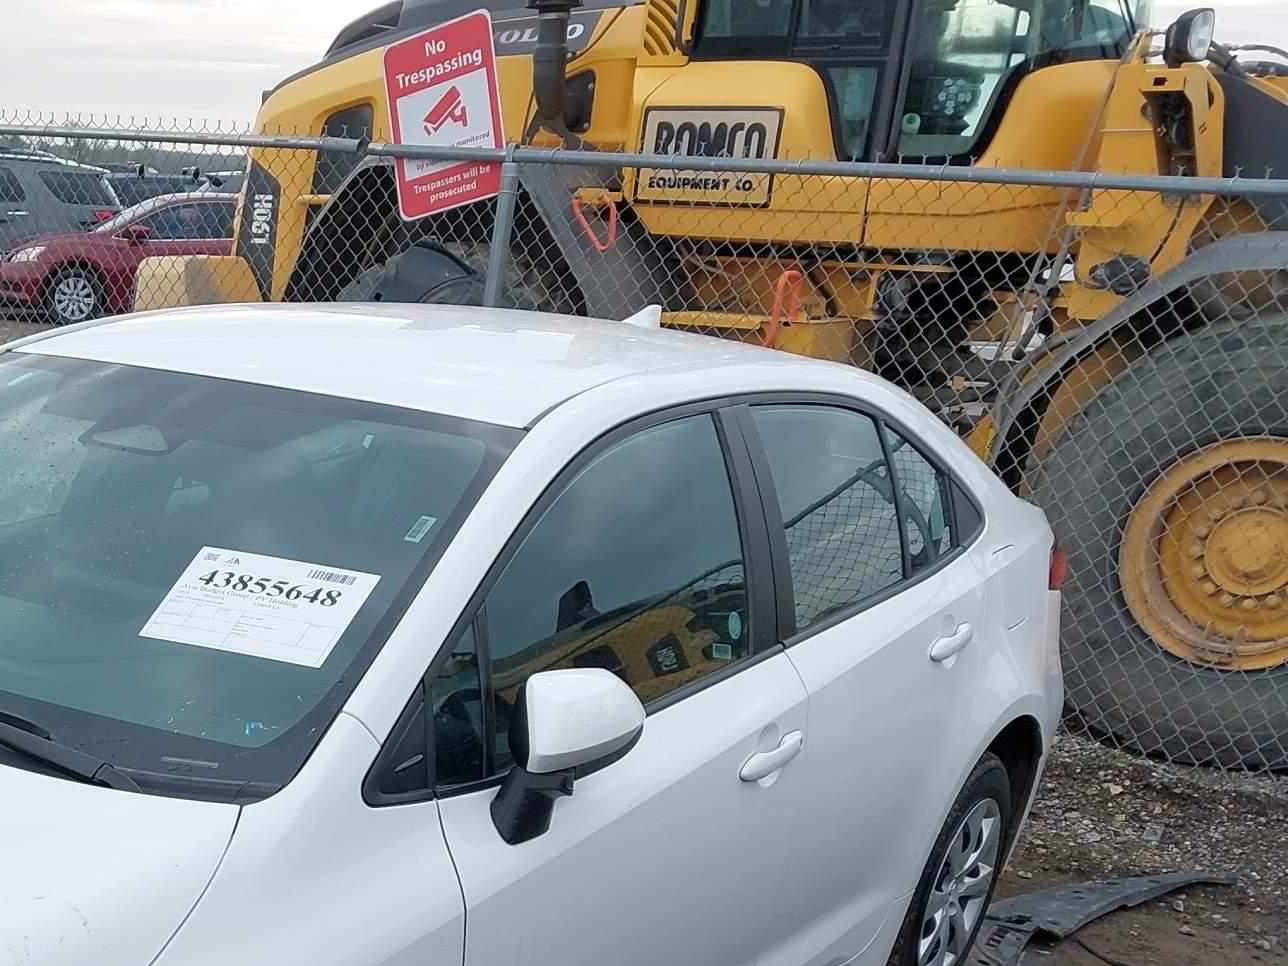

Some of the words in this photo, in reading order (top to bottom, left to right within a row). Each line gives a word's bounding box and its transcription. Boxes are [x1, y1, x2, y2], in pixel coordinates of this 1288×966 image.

[494, 23, 585, 44] OLO
[424, 39, 446, 57] No
[396, 48, 483, 90] Trespassing
[456, 130, 490, 147] monitored
[654, 121, 767, 160] ROMCO
[414, 175, 461, 194] Trespassers
[462, 168, 479, 180] will
[479, 164, 491, 176] be
[648, 176, 730, 191] EQUIPMENT
[430, 179, 477, 204] prosecuted
[199, 569, 342, 607] 43855648
[226, 590, 249, 601] Group
[269, 597, 300, 609] Holding
